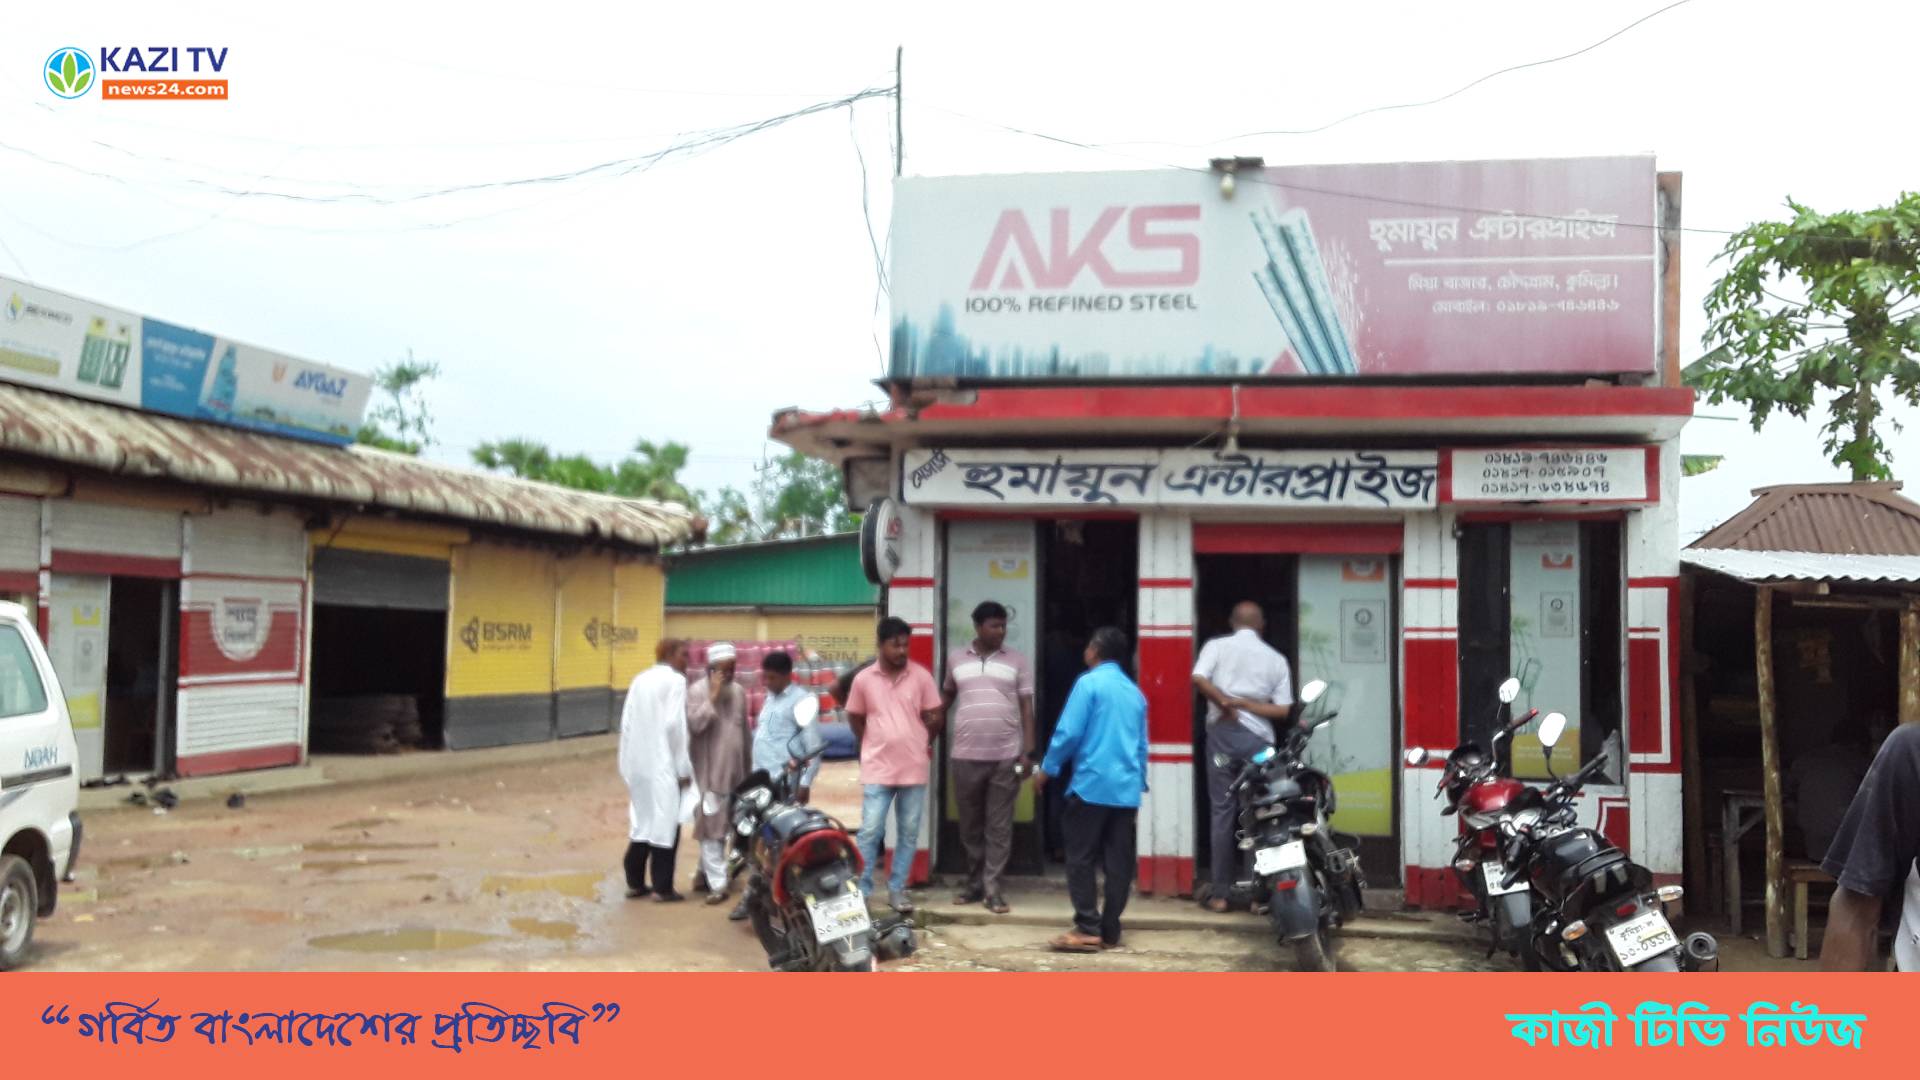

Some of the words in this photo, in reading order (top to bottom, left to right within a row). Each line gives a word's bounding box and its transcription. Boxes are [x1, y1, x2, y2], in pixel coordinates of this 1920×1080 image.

[969, 203, 1201, 291] AKS
[965, 296, 1021, 313] 100%
[1027, 295, 1124, 313] REFINED
[1129, 293, 1198, 311] STEEL
[483, 622, 532, 641] BSRM
[24, 746, 58, 768] NOAH
